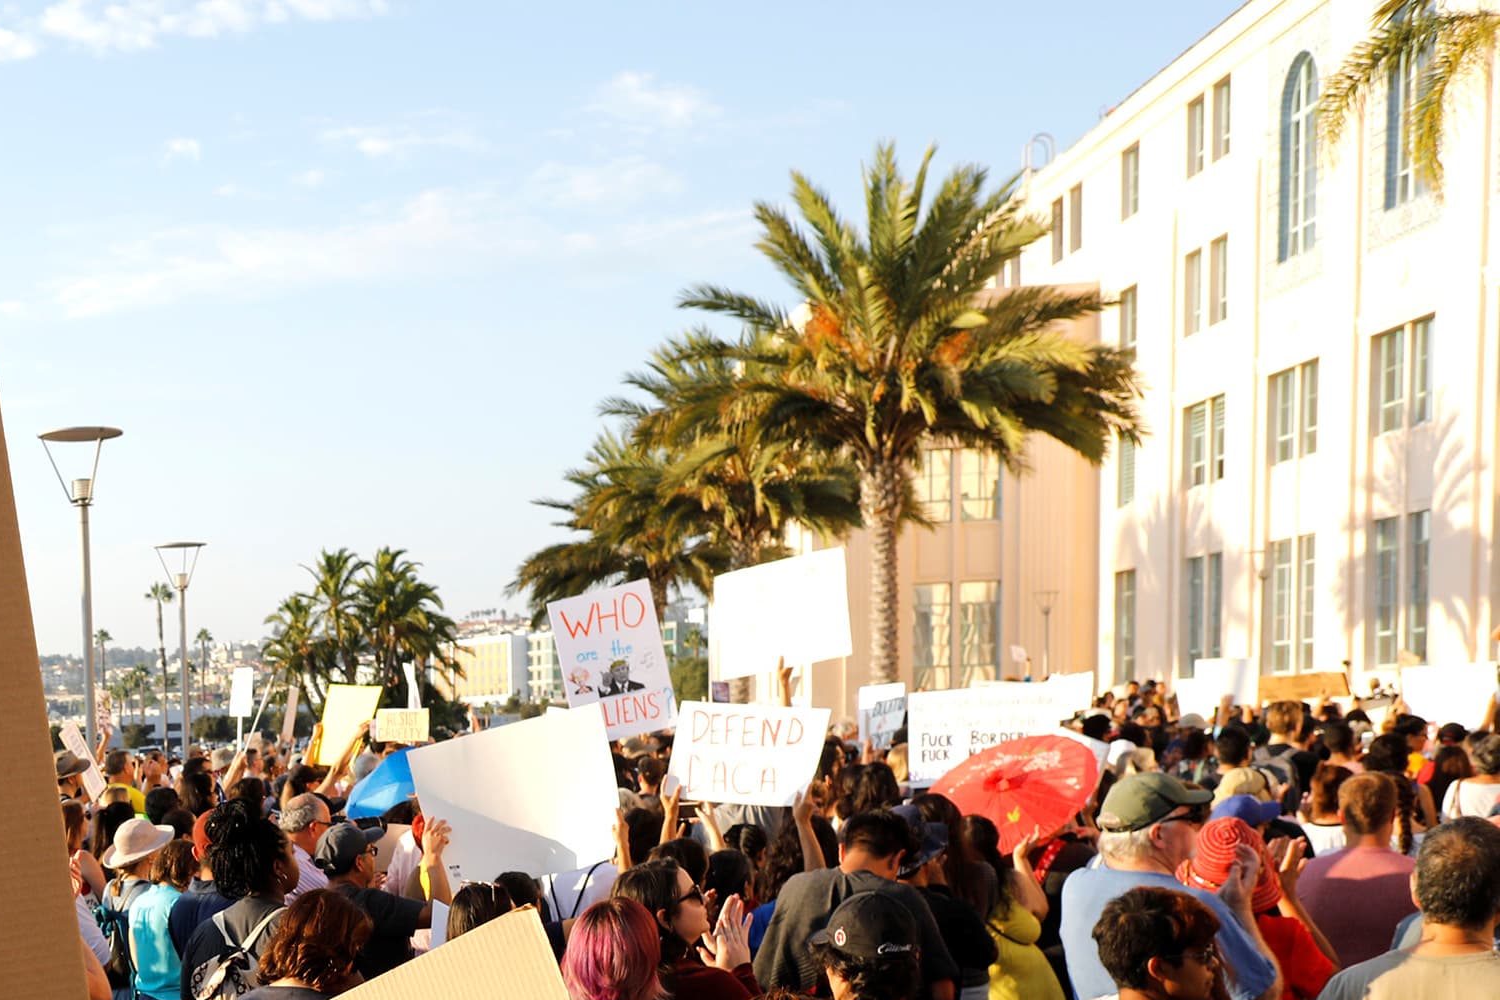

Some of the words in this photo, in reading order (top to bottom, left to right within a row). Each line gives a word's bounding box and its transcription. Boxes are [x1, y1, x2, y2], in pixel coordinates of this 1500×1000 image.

[560, 592, 646, 639] WHO
[576, 650, 599, 663] are
[611, 639, 634, 657] the
[692, 710, 804, 747] DEFEND
[921, 732, 953, 747] FUCK
[970, 729, 1029, 745] BORDER
[921, 749, 949, 763] FUCK
[688, 754, 777, 795] DACA
